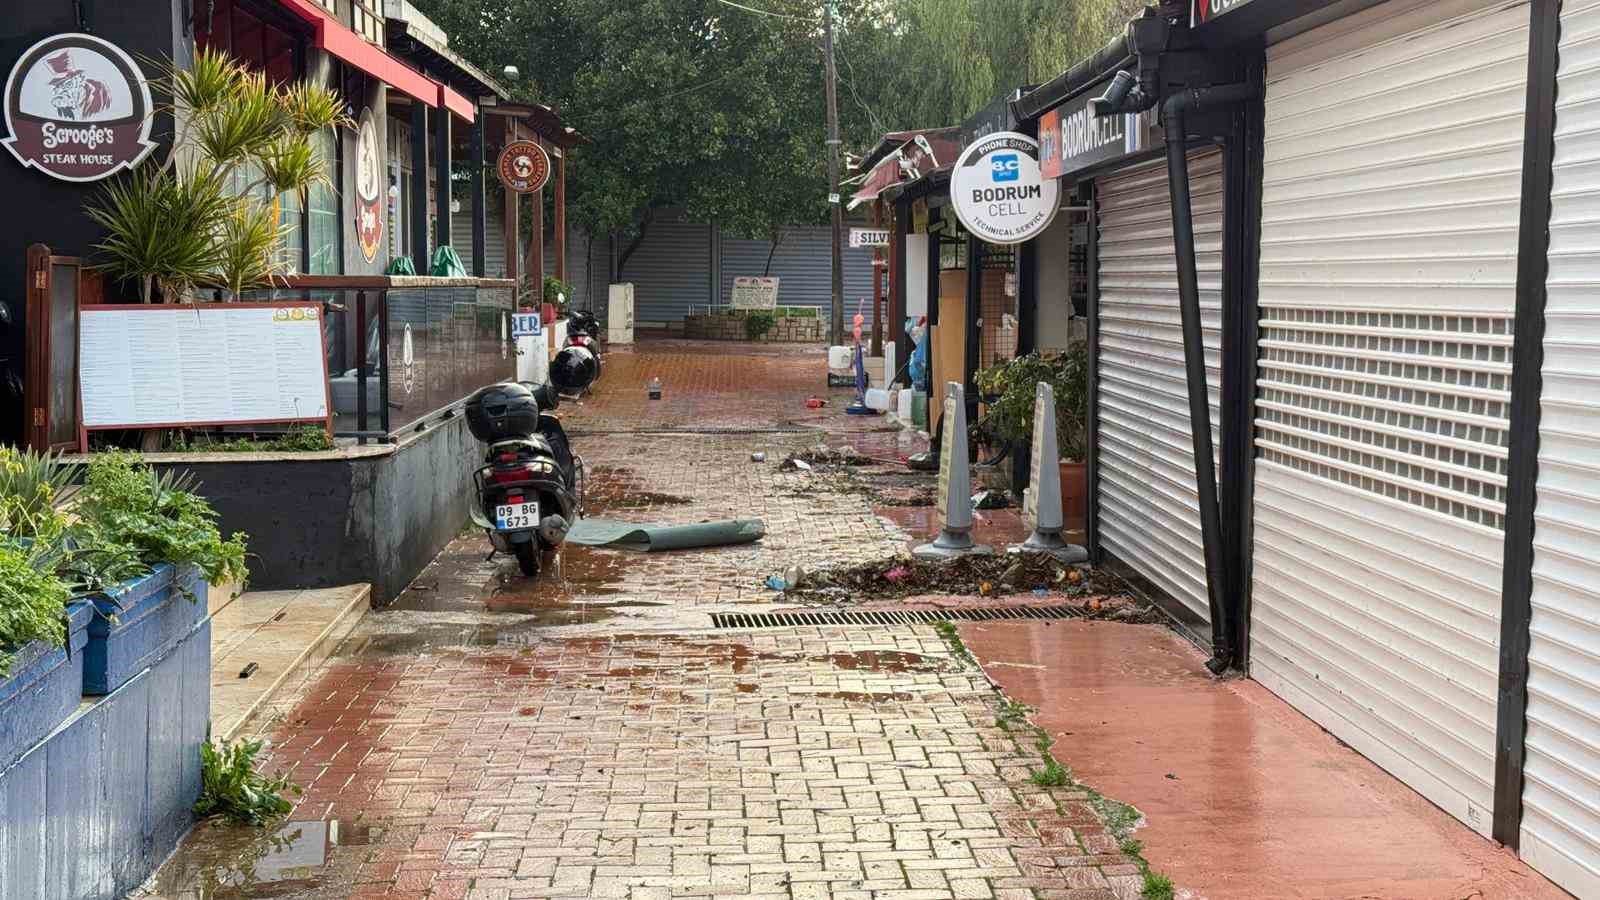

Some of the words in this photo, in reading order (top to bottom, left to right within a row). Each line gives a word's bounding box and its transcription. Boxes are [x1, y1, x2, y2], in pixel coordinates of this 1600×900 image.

[41, 122, 114, 150] Scrooge's
[978, 139, 1009, 155] PHONE
[1009, 139, 1033, 152] SHOP
[43, 153, 77, 165] STEAK
[80, 153, 113, 165] HOUSE
[972, 185, 1041, 203] BODRUM
[988, 203, 1027, 217] CELL
[973, 216, 1014, 236] TECHNICAL
[1015, 211, 1045, 233] SERVICE
[498, 506, 513, 517] 09
[506, 516, 529, 528] 673
